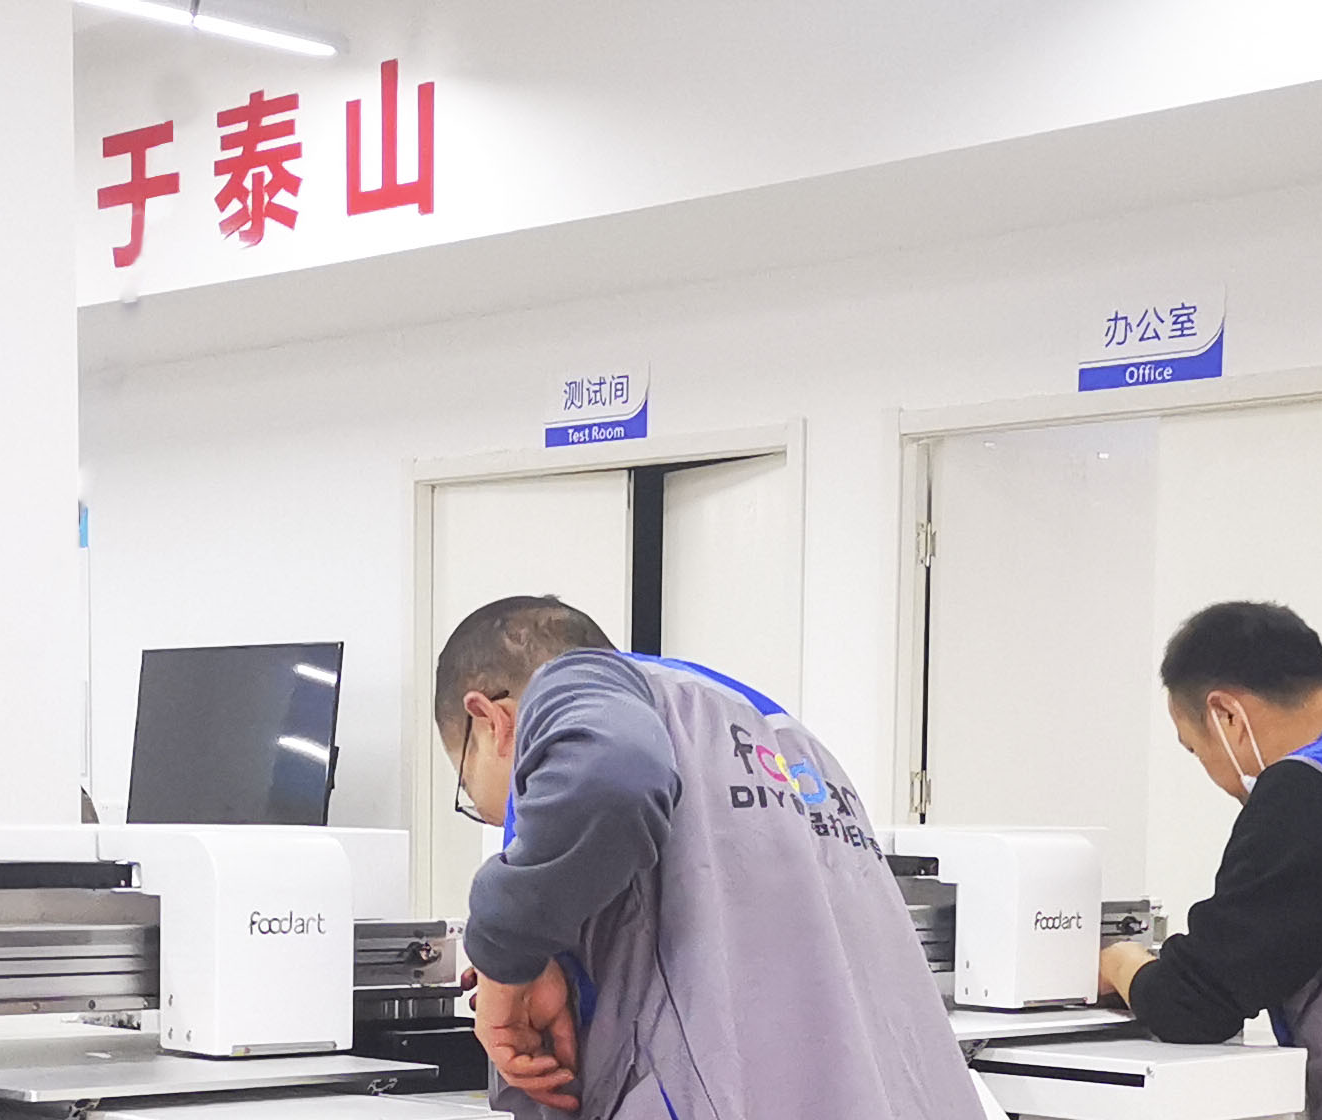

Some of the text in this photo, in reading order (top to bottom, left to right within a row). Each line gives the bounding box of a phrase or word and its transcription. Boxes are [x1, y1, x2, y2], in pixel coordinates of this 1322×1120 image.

[97, 58, 435, 268] 于泰山
[1105, 302, 1197, 348] 办公室
[1125, 364, 1173, 385] Office
[563, 374, 629, 411] 测试间
[567, 426, 625, 443] Test Room
[248, 911, 326, 935] foodart
[1034, 910, 1082, 931] foodart
